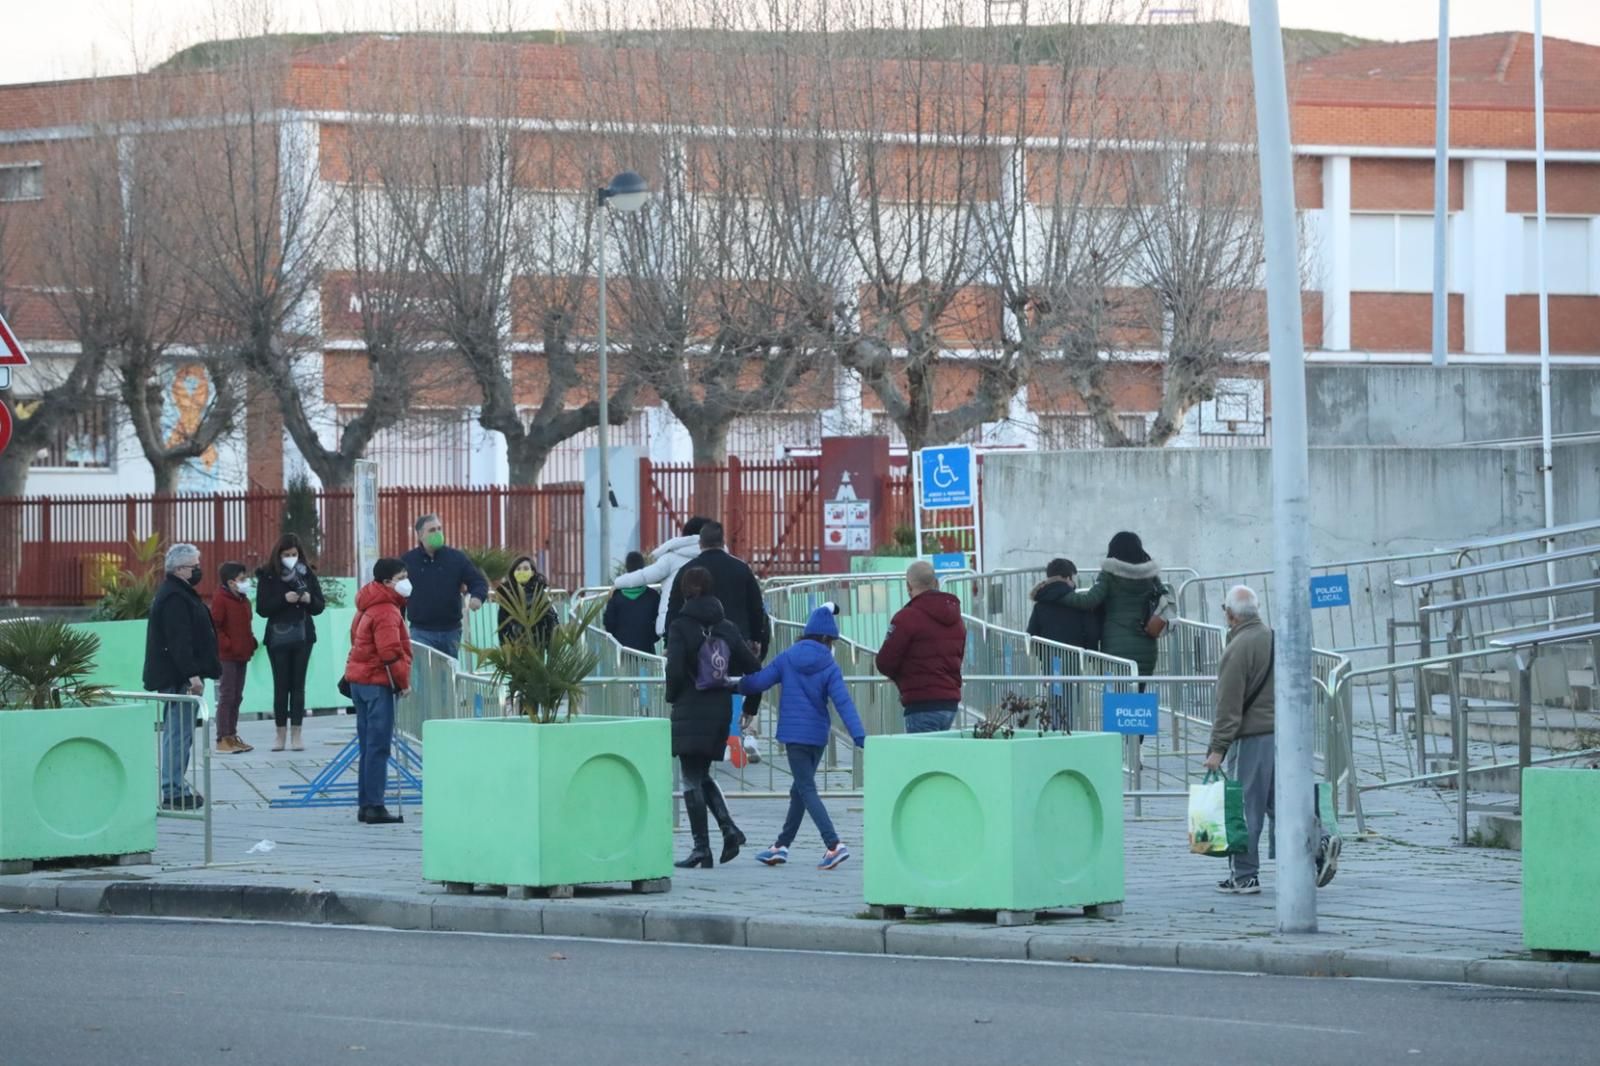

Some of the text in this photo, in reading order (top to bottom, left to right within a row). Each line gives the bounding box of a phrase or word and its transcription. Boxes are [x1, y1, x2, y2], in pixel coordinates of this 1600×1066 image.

[1315, 586, 1343, 595] POLICIA
[1318, 594, 1342, 602] LOCAL
[1115, 707, 1152, 718] POLICIA
[1118, 718, 1149, 728] LOCAL
